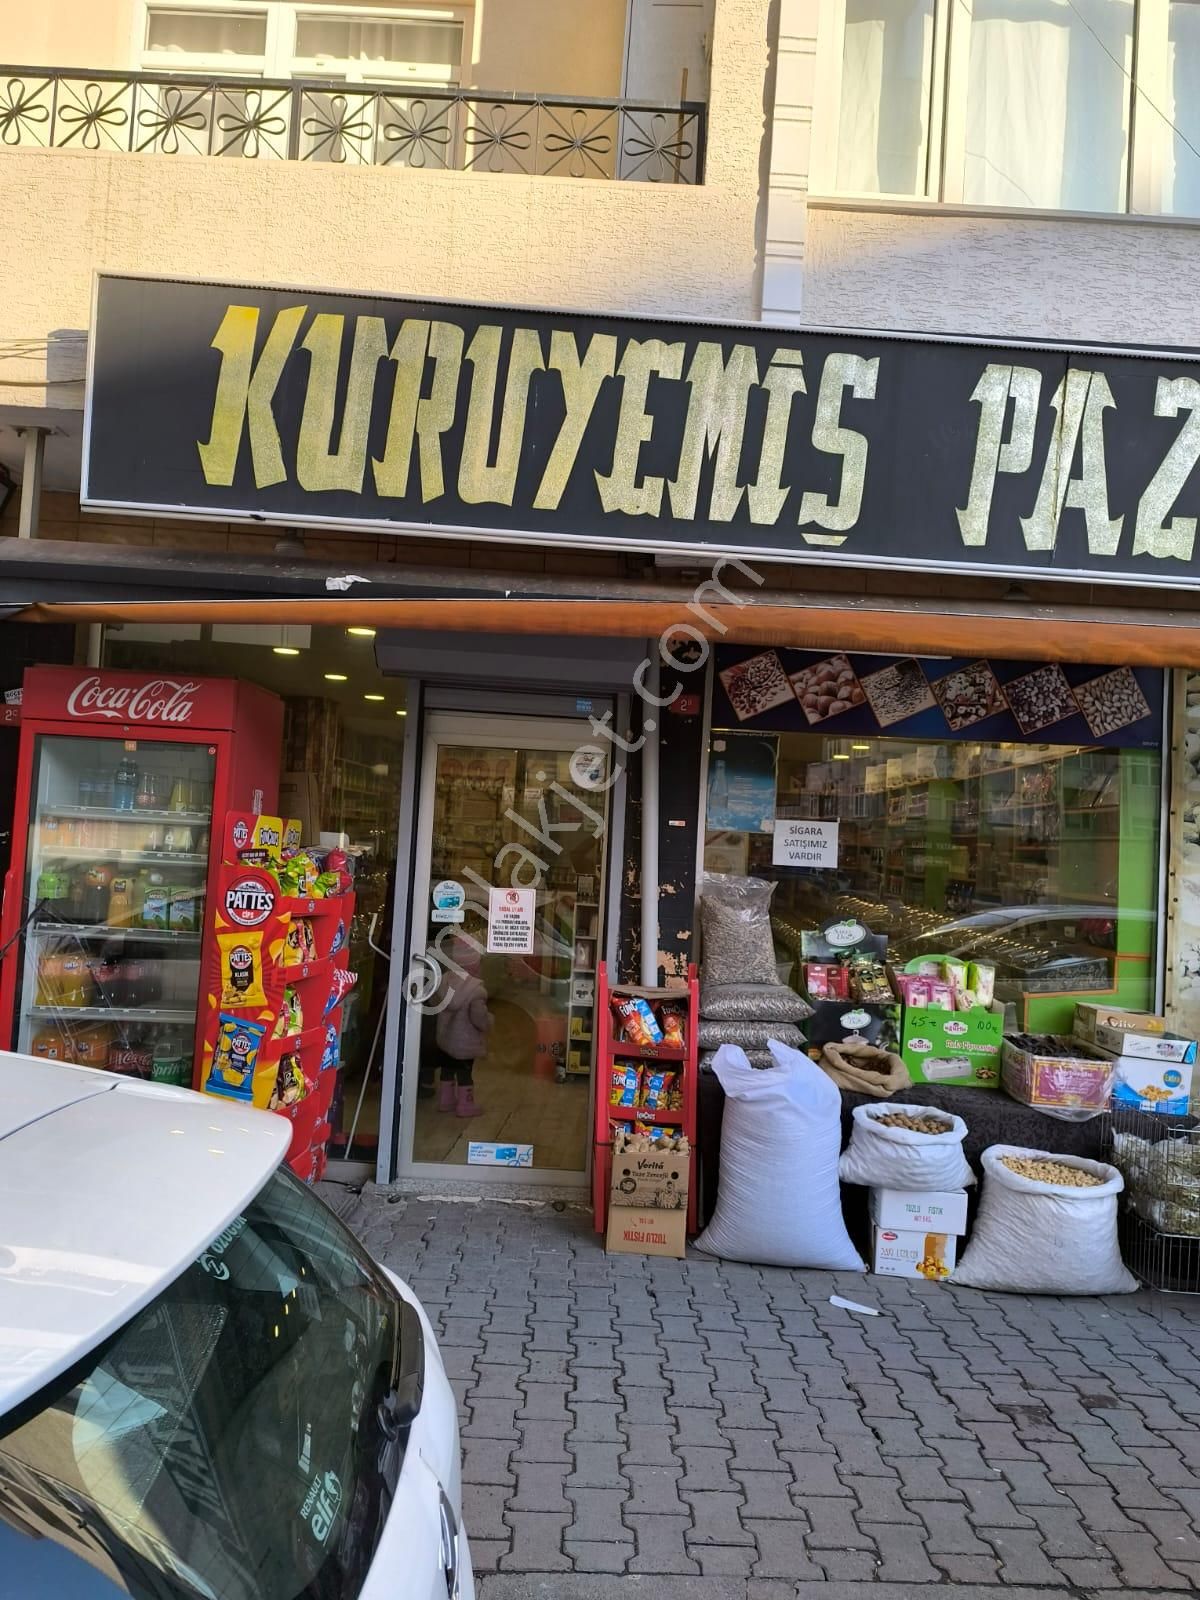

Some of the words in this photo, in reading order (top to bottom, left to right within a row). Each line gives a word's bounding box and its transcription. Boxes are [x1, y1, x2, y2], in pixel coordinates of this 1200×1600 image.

[789, 825, 823, 836] SİGARA
[784, 839, 828, 849] SATIŞIMIZ
[789, 852, 822, 861] VARDIR
[226, 890, 275, 911] PATTES
[230, 952, 252, 962] PATTES
[231, 1038, 252, 1049] PATTES
[300, 1473, 323, 1520] RENAULT
[311, 1488, 334, 1541] elf
